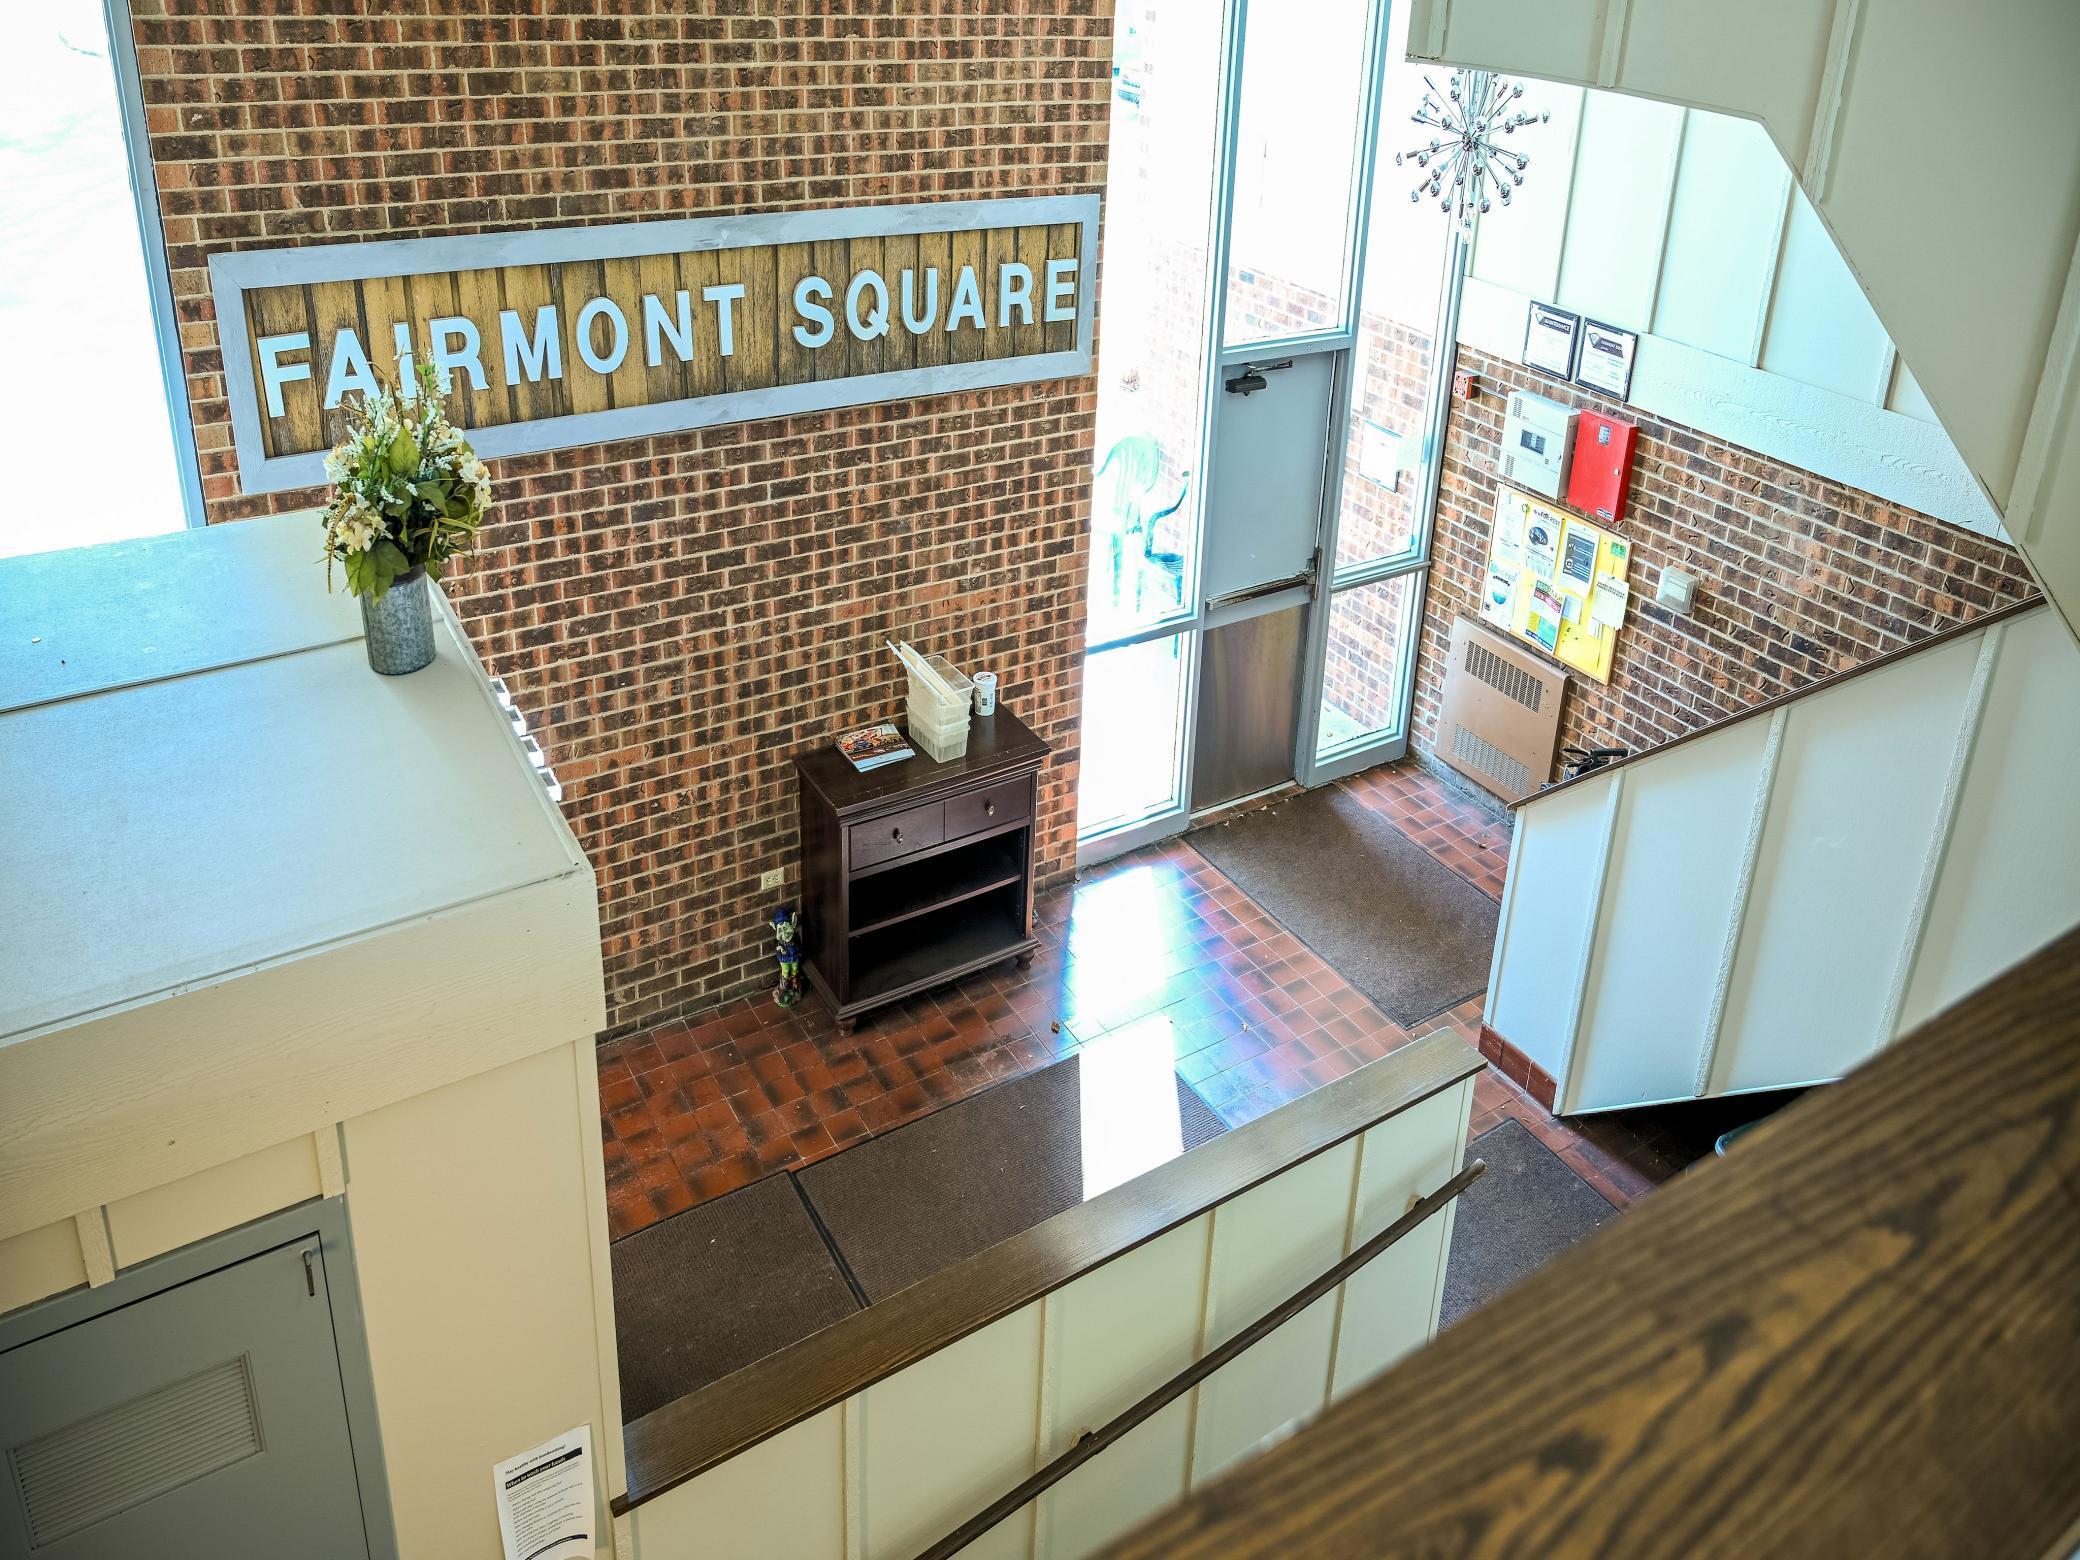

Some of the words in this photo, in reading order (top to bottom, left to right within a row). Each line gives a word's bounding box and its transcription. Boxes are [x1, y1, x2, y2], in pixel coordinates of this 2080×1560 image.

[257, 284, 745, 418] FAIRMONT
[792, 258, 1078, 348] SQUARE
[506, 1478, 520, 1488] When
[526, 1468, 540, 1477] wash
[540, 1464, 551, 1474] your
[551, 1456, 566, 1466] hands
